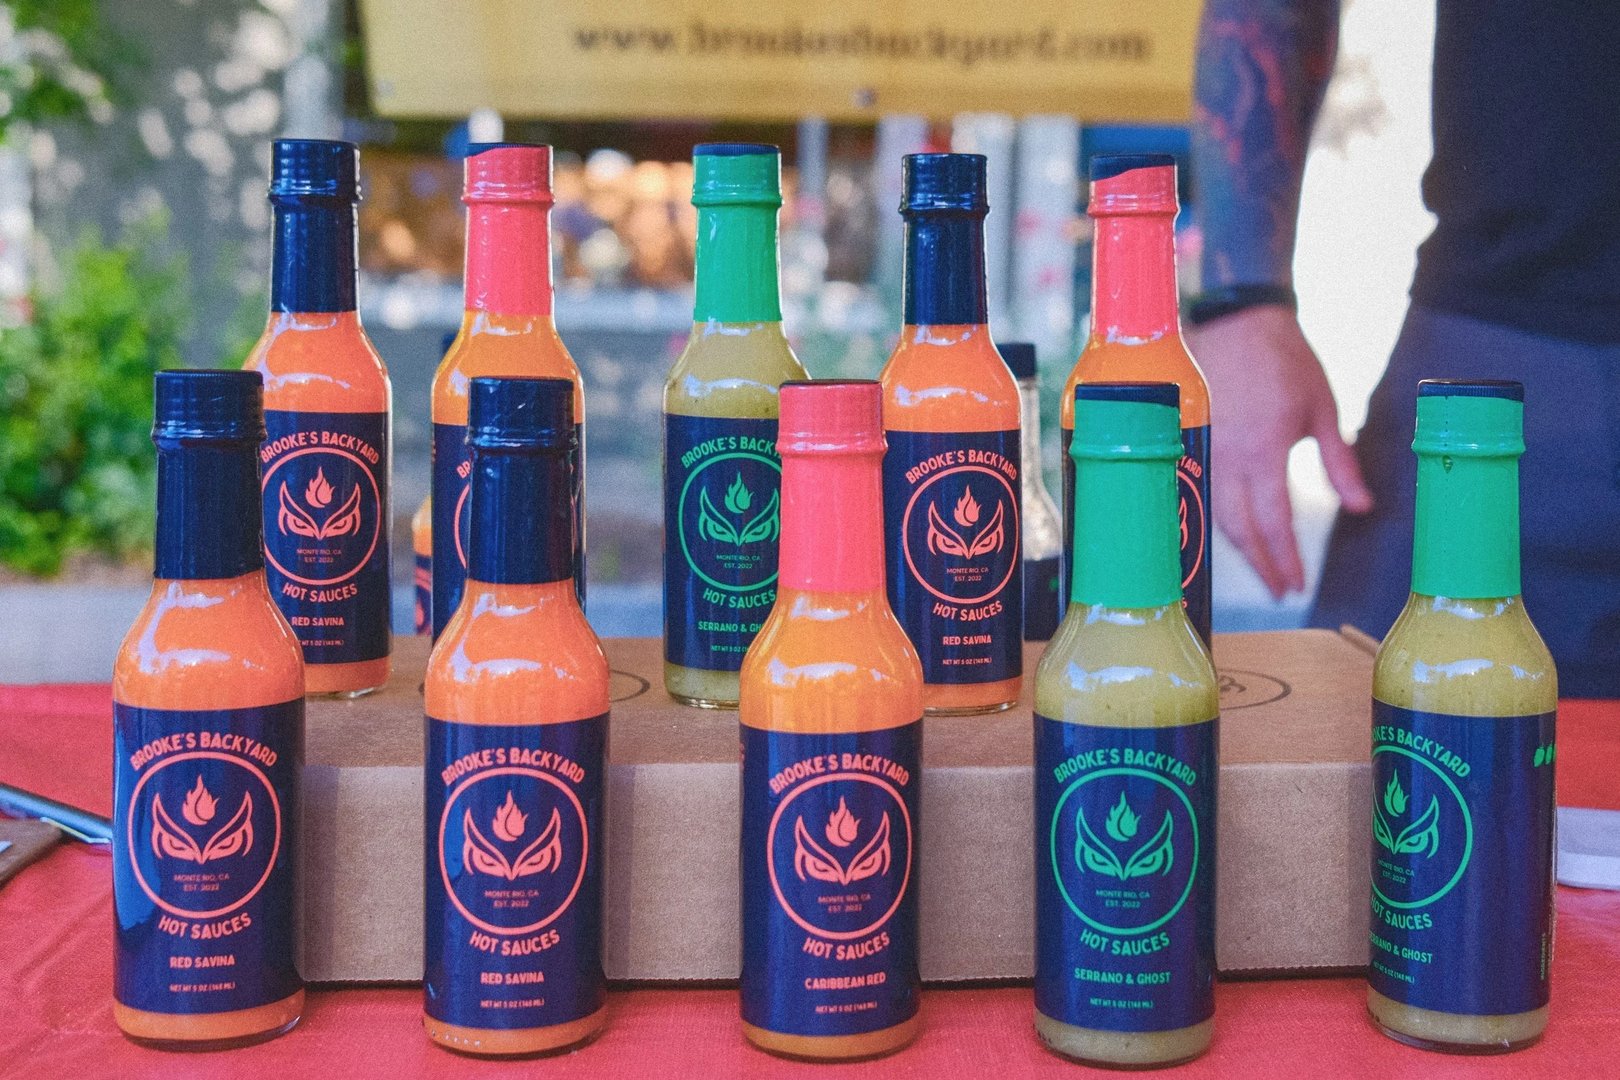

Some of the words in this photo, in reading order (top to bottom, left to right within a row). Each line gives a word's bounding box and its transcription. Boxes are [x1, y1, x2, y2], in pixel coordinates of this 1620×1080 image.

[260, 431, 319, 463] BROOKE'S
[321, 431, 379, 464] BACKYARD
[680, 436, 737, 468] BROOKE'S
[740, 436, 782, 459] BACK
[905, 449, 966, 484] BROOKE'S
[968, 449, 1018, 480] BACKYARD
[282, 582, 308, 601] HOT
[309, 583, 358, 602] SAUCES
[702, 588, 727, 606] HOT
[728, 589, 776, 609] SAUCES
[291, 616, 311, 626] RED
[311, 616, 345, 626] SAVINA
[932, 602, 958, 620] HOT
[959, 600, 1003, 621] SAUCES
[697, 621, 739, 632] SERRANO
[740, 623, 748, 633] &
[942, 636, 961, 645] RED
[962, 635, 992, 645] SAVINA
[130, 732, 197, 771] BROOKE'S
[200, 731, 278, 767] BACKYARD
[1396, 728, 1471, 778] BACKYARD
[441, 748, 507, 786] BROOKE'S
[509, 747, 586, 784] BACKYARD
[768, 754, 839, 795] BROOKE'S
[842, 753, 910, 787] BACKYARD
[1053, 748, 1121, 784] BROOKE'S
[1123, 748, 1197, 786] BACKYARD
[158, 915, 188, 938] HOT
[190, 912, 252, 940] SAUCES
[1385, 911, 1433, 930] SAUCES
[469, 930, 499, 953] HOT
[501, 929, 560, 956] SAUCES
[802, 937, 834, 959] HOT
[836, 931, 890, 961] SAUCES
[1080, 928, 1109, 952] HOT
[1111, 932, 1170, 956] SAUCES
[1393, 945, 1400, 956] &
[1401, 947, 1433, 963] GHOST
[169, 956, 193, 969] RED
[194, 954, 235, 969] SAVINA
[480, 972, 503, 985] RED
[504, 971, 545, 985] SAVINA
[804, 976, 865, 990] CARIBBEAN
[866, 971, 886, 986] RED
[1074, 967, 1123, 984] SERRANO
[1125, 973, 1135, 985] &
[1136, 971, 1171, 985] GHOST
